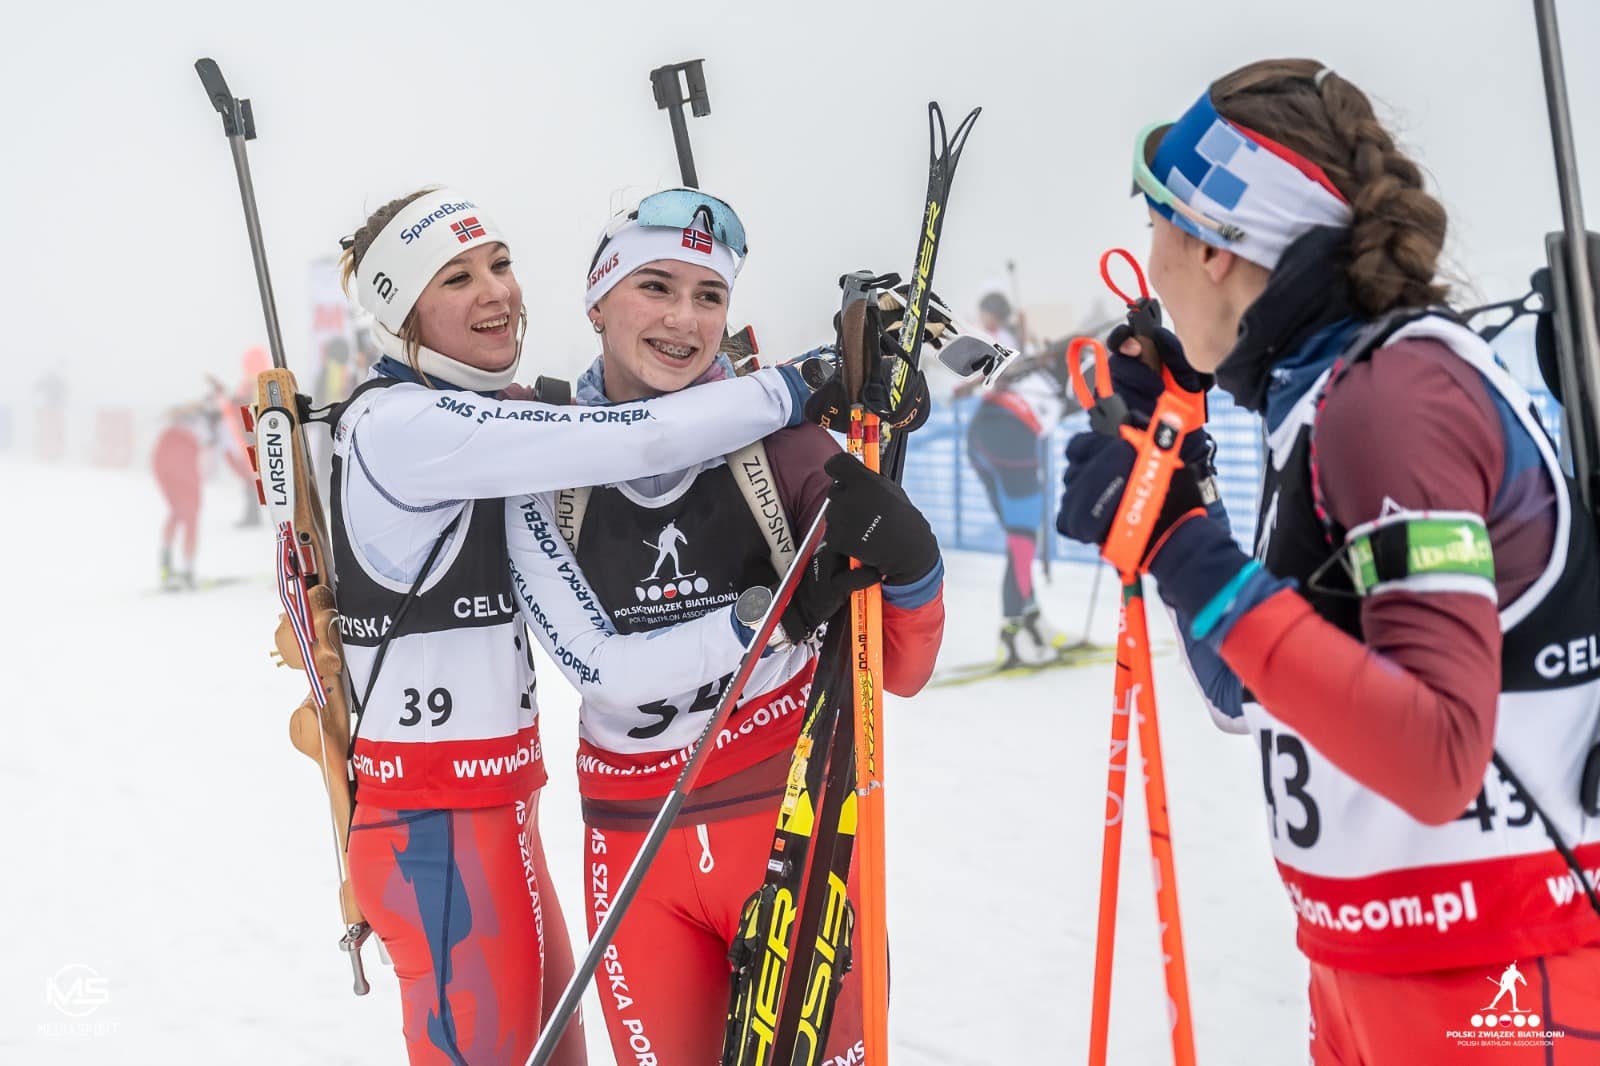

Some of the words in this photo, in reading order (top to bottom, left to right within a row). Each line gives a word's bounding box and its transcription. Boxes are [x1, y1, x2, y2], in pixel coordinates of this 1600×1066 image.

[436, 396, 476, 418] SMS
[477, 407, 571, 424] SLARSKA
[266, 433, 287, 506] LARSEN
[743, 455, 793, 554] ANSCHÜTZ
[614, 605, 644, 618] POLSK
[685, 591, 739, 609] BIATHLONU
[398, 687, 453, 727] 39
